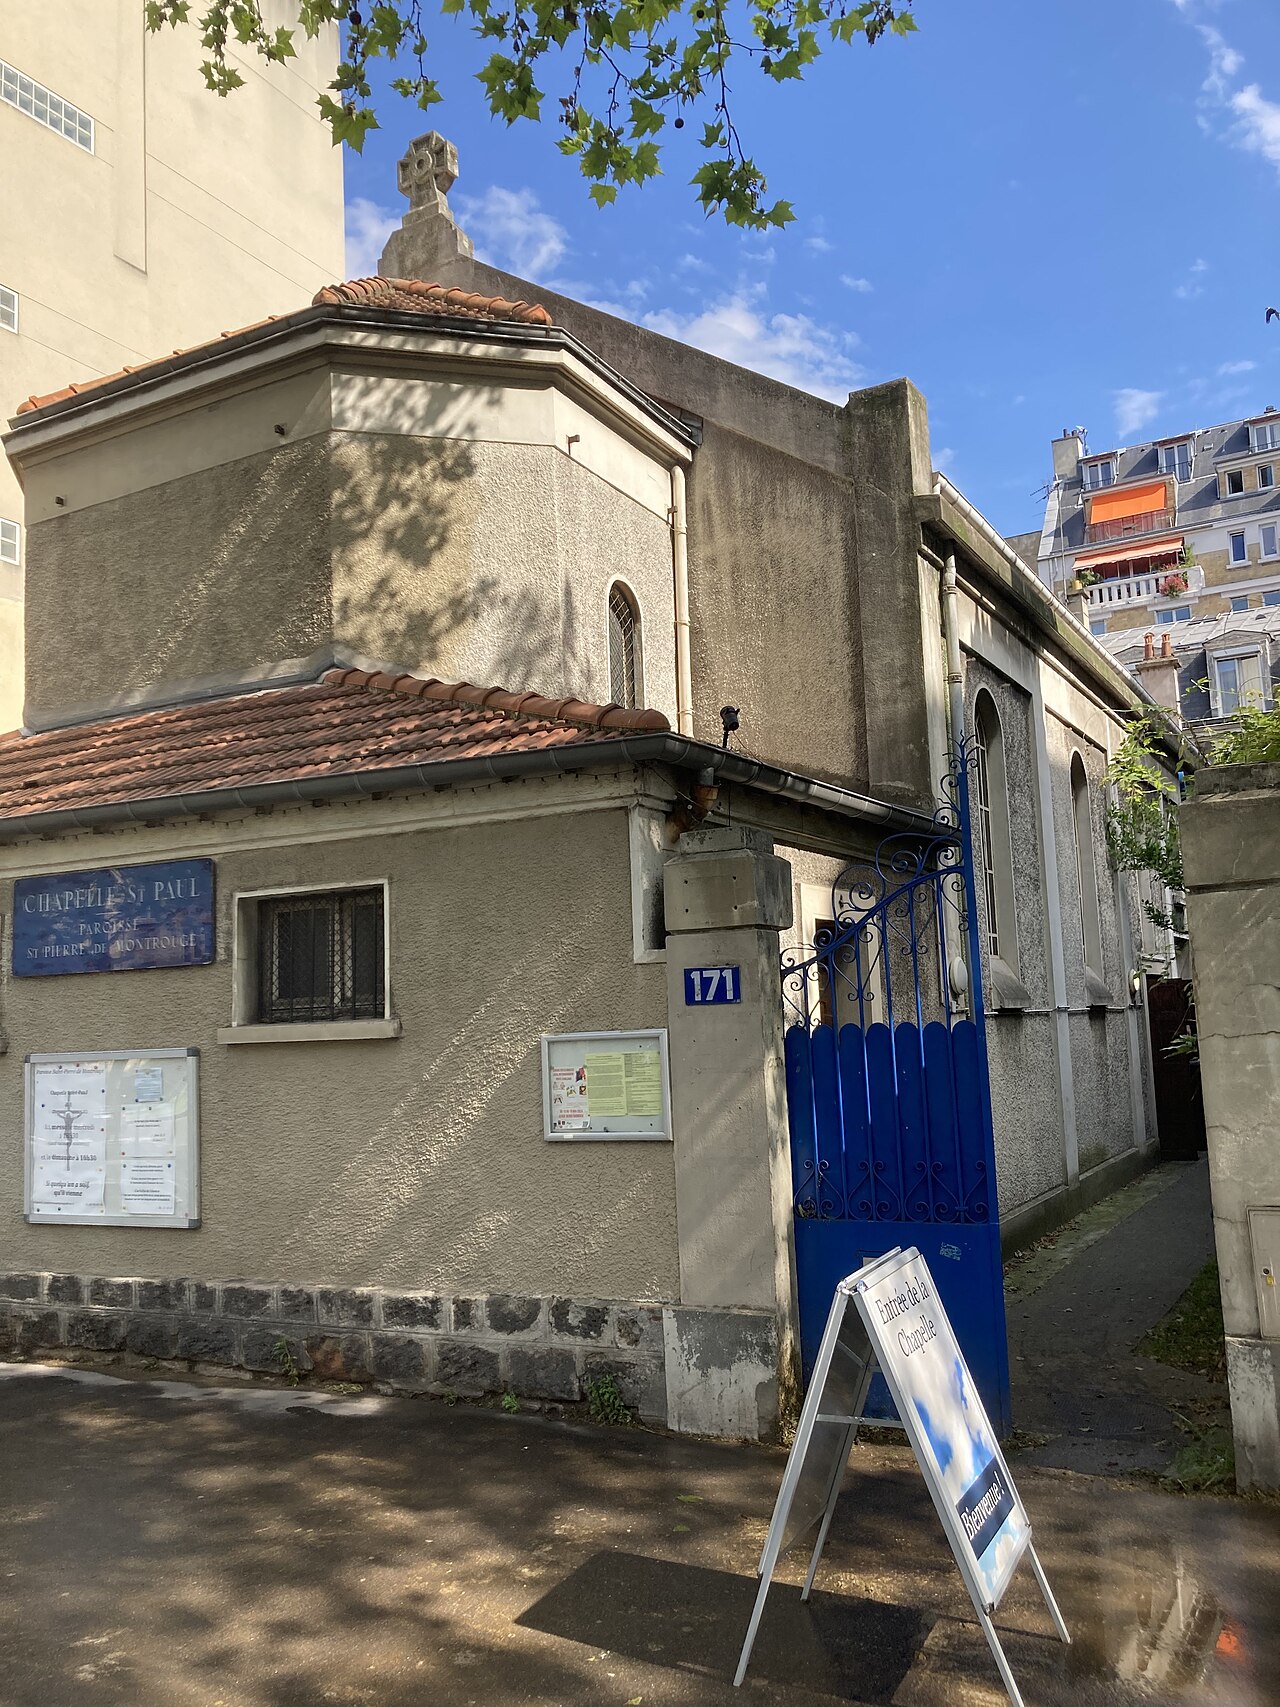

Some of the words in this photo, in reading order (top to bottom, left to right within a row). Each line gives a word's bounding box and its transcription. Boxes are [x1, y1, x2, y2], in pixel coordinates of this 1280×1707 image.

[24, 886, 116, 913] CHAPELLE
[154, 877, 200, 901] PAUL
[79, 919, 140, 936] PAROISSE
[44, 942, 86, 958] PIERRE
[94, 942, 106, 955] DE
[113, 934, 197, 952] MONTROUGE
[690, 969, 734, 1001] 171
[875, 1288, 909, 1325] Entrée
[905, 1281, 920, 1306] de
[914, 1276, 930, 1300] la
[897, 1314, 937, 1357] Chapelle
